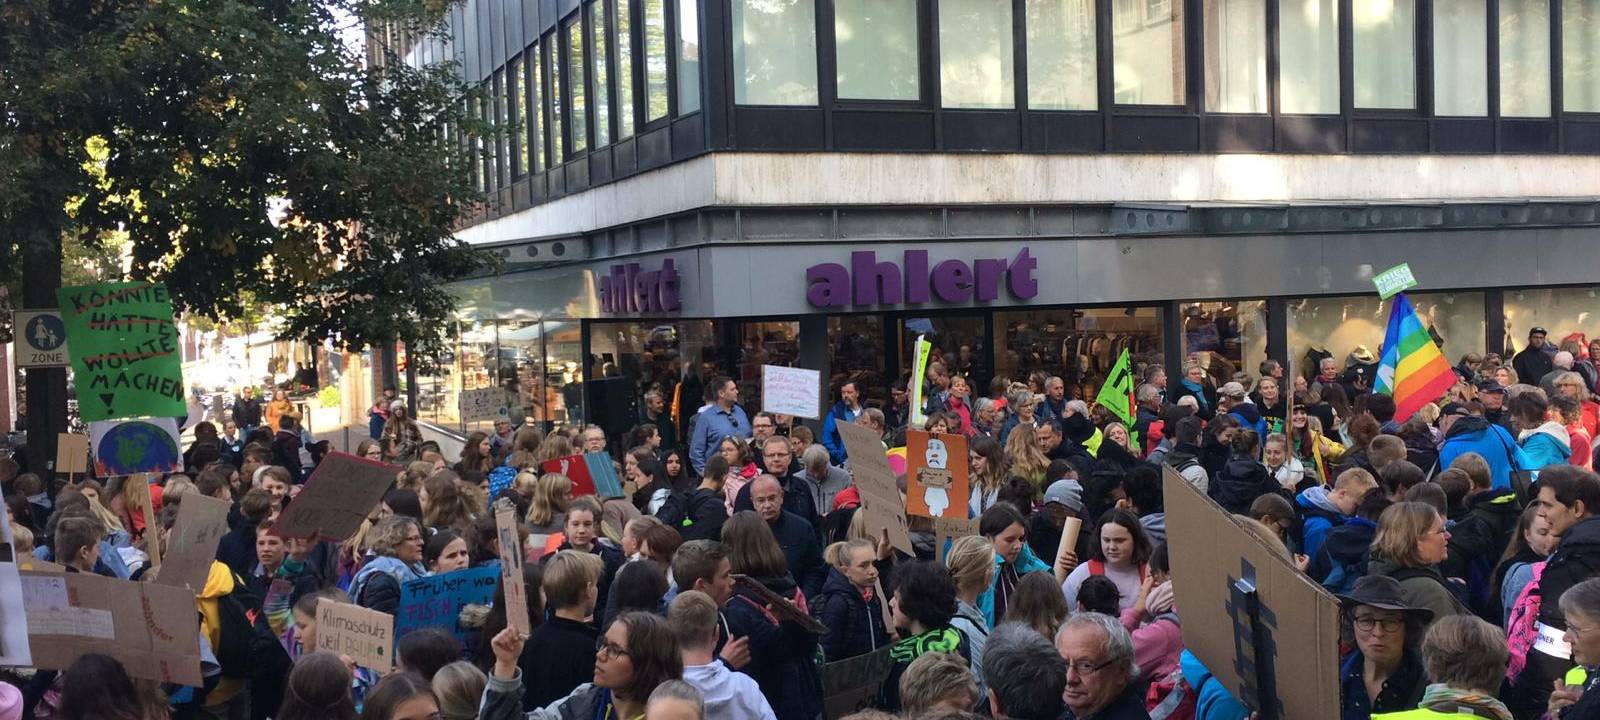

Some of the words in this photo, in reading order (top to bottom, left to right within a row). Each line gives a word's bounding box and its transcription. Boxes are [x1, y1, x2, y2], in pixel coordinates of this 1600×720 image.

[599, 258, 681, 313] ahlert
[806, 247, 1038, 308] ahlert
[31, 352, 64, 363] ZONE
[90, 372, 185, 402] MACHEN
[322, 607, 386, 639] Klimaschutz
[318, 631, 341, 651] weil
